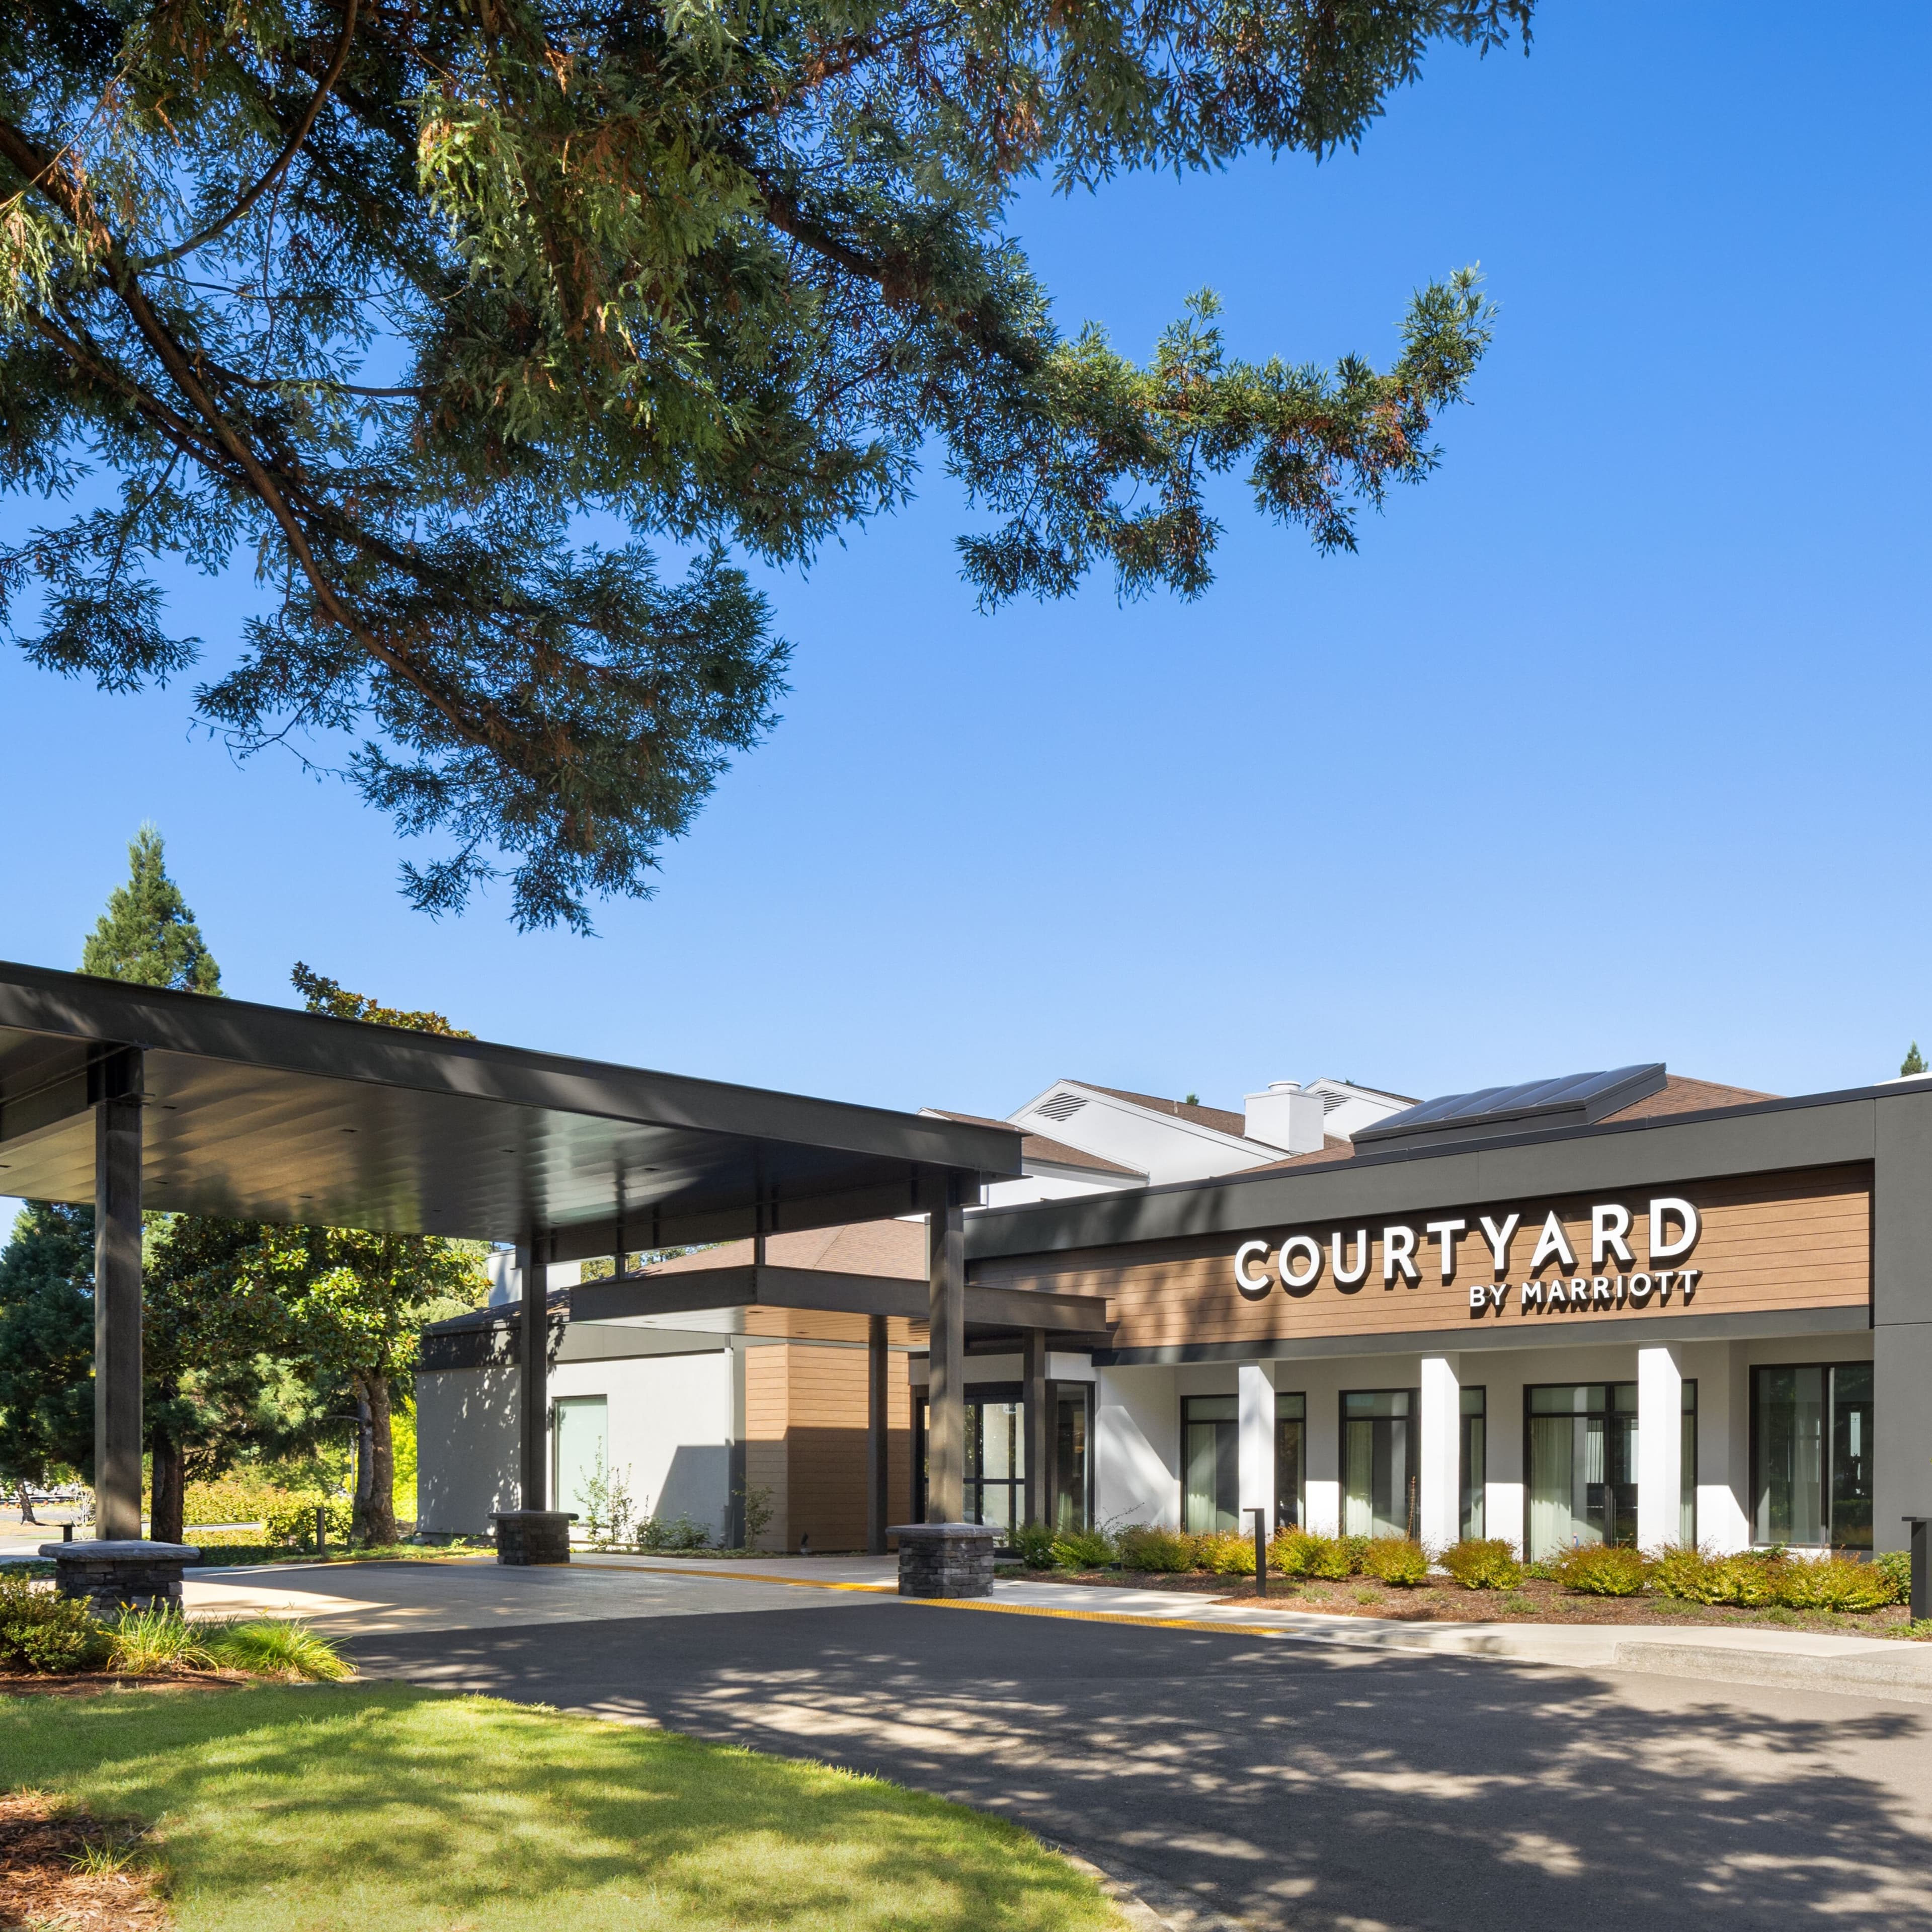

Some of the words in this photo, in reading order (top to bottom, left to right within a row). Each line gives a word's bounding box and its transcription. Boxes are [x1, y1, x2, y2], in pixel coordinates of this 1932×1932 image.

[1233, 1197, 1699, 1291] COURTYARD
[1469, 1283, 1507, 1307] BY
[1521, 1269, 1699, 1305] MARRIOTT
